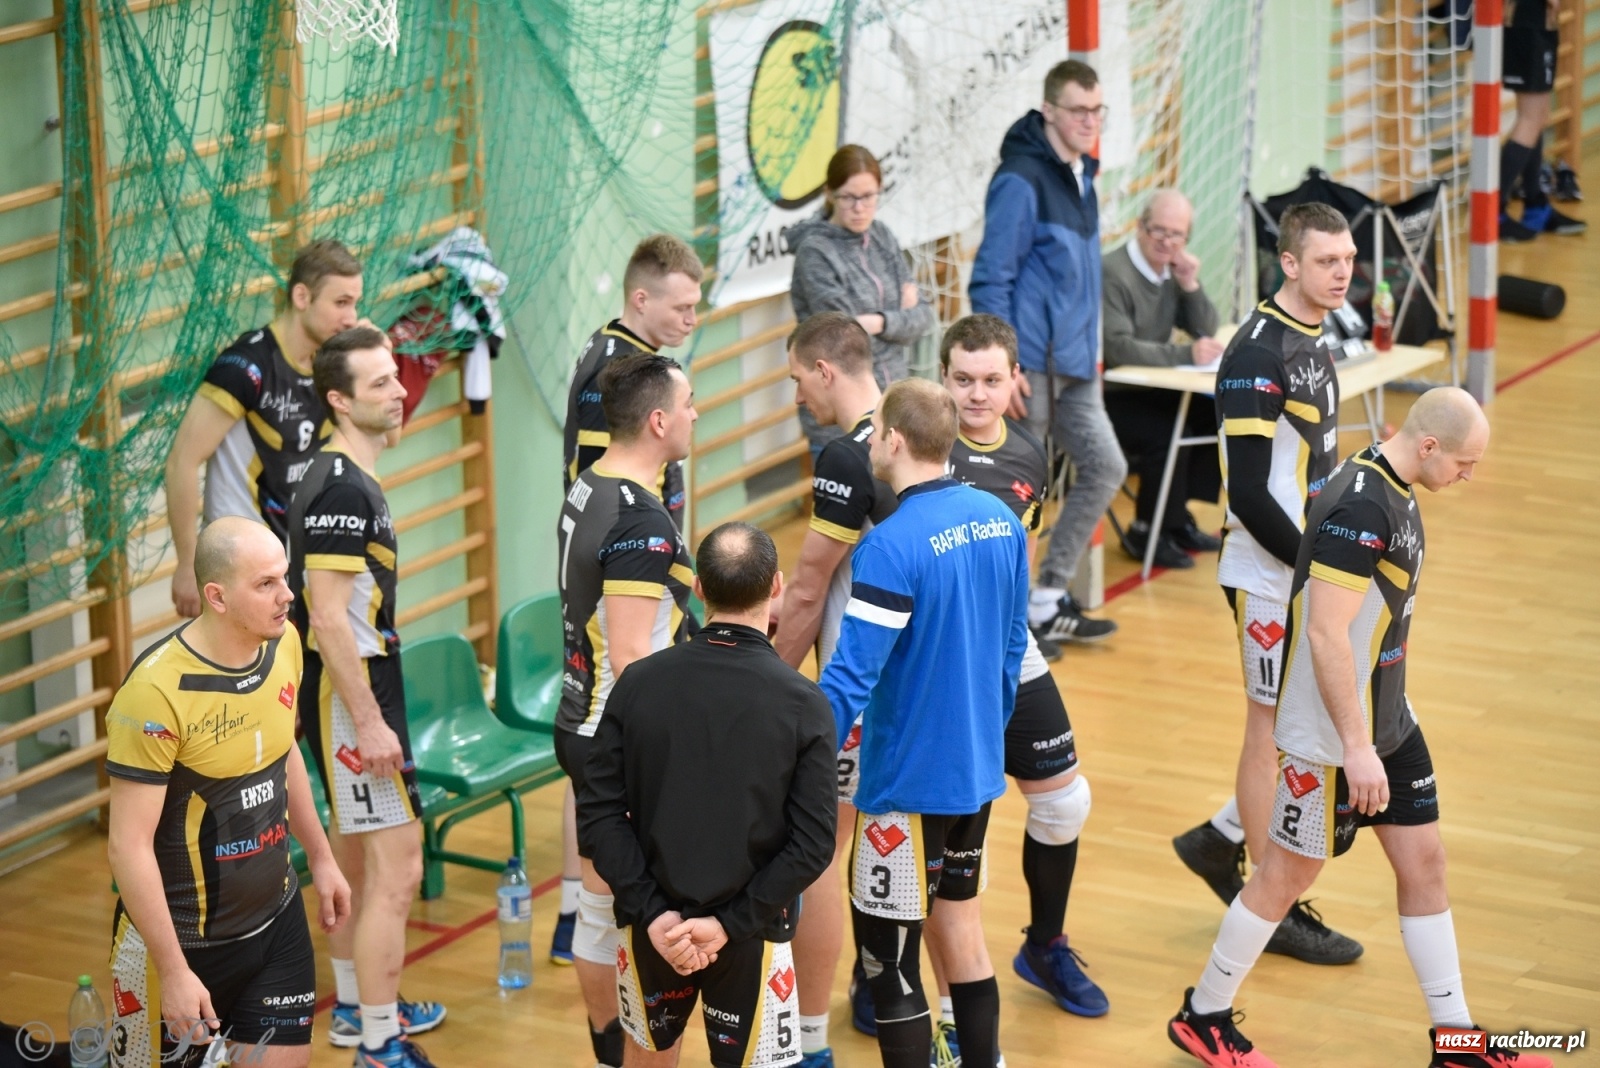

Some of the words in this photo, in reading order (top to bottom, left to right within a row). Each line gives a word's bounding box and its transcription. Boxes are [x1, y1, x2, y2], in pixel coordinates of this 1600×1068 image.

[297, 419, 315, 453] 6
[561, 513, 577, 591] 7
[1259, 656, 1274, 688] 11
[241, 778, 275, 810] ENTER
[352, 782, 374, 815] 4
[1282, 804, 1303, 838] 2
[869, 864, 891, 900] 3
[777, 1010, 792, 1049] 5
